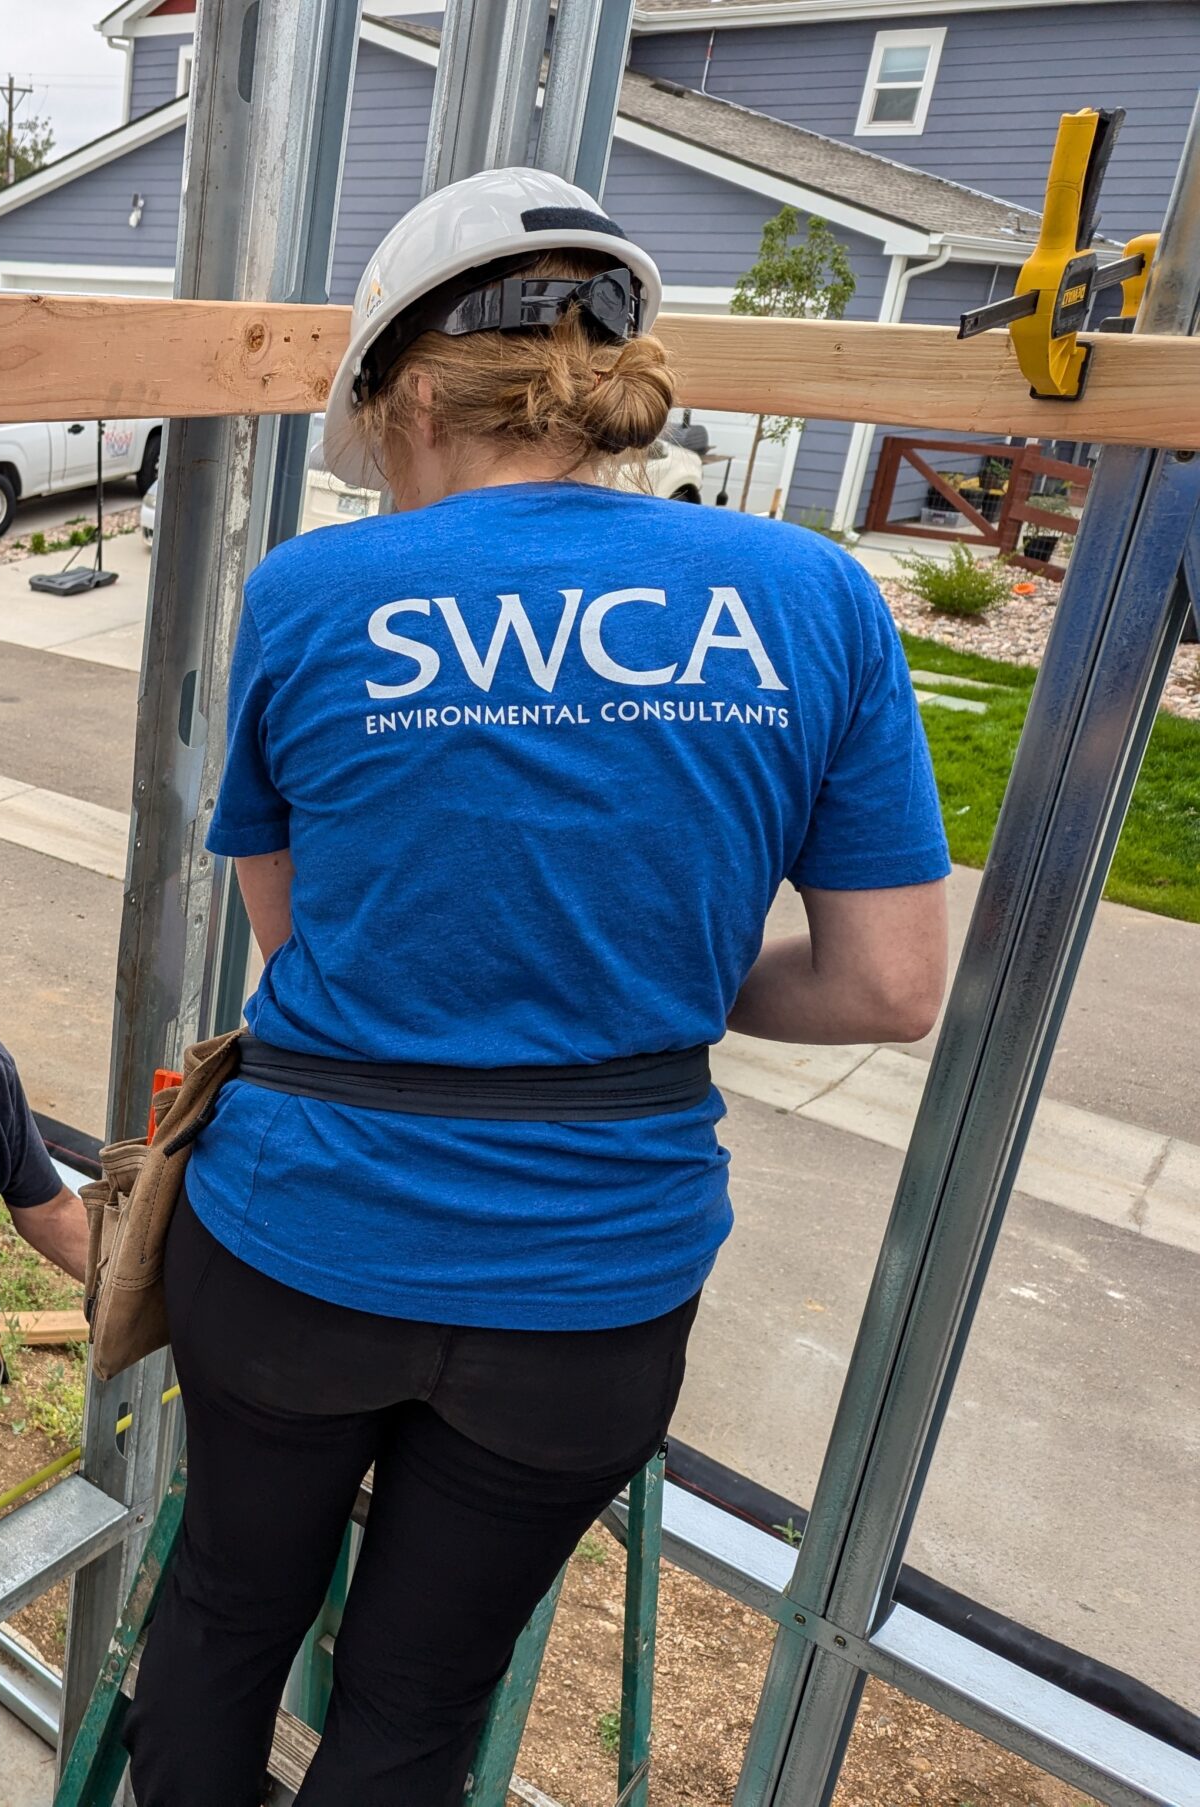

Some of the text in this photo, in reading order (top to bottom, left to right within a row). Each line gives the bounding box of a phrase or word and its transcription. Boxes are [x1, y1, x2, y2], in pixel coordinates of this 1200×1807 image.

[365, 586, 789, 699] SWCA
[366, 700, 789, 735] ENVIRONMENTAL CONSULTANTS
